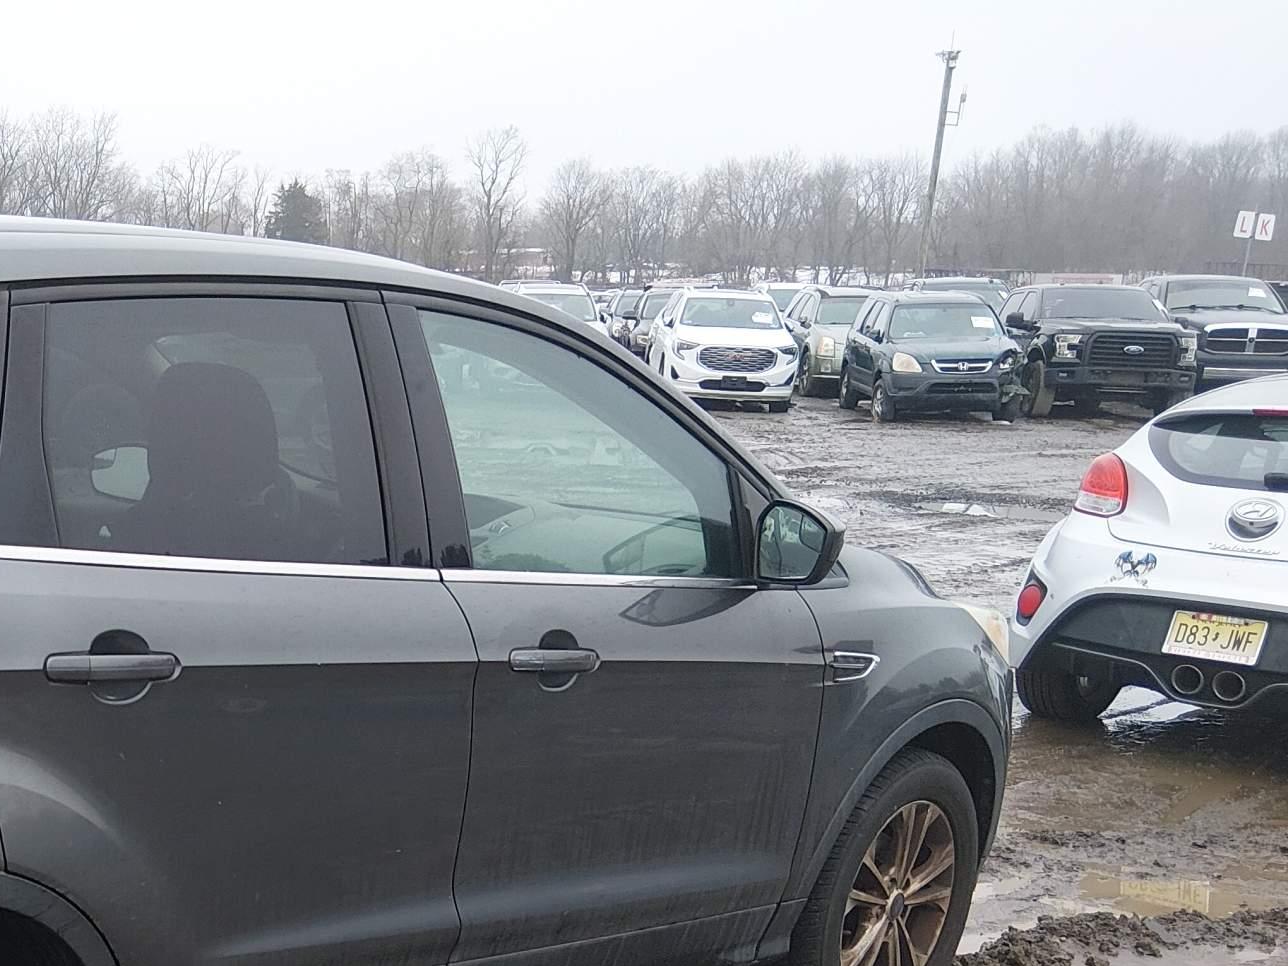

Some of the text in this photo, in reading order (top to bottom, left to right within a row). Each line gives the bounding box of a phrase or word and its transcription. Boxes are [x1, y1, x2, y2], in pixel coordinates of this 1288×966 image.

[1239, 215, 1248, 233] L
[1259, 219, 1271, 236] K
[1174, 623, 1210, 646] D83
[1220, 629, 1258, 652] JWF
